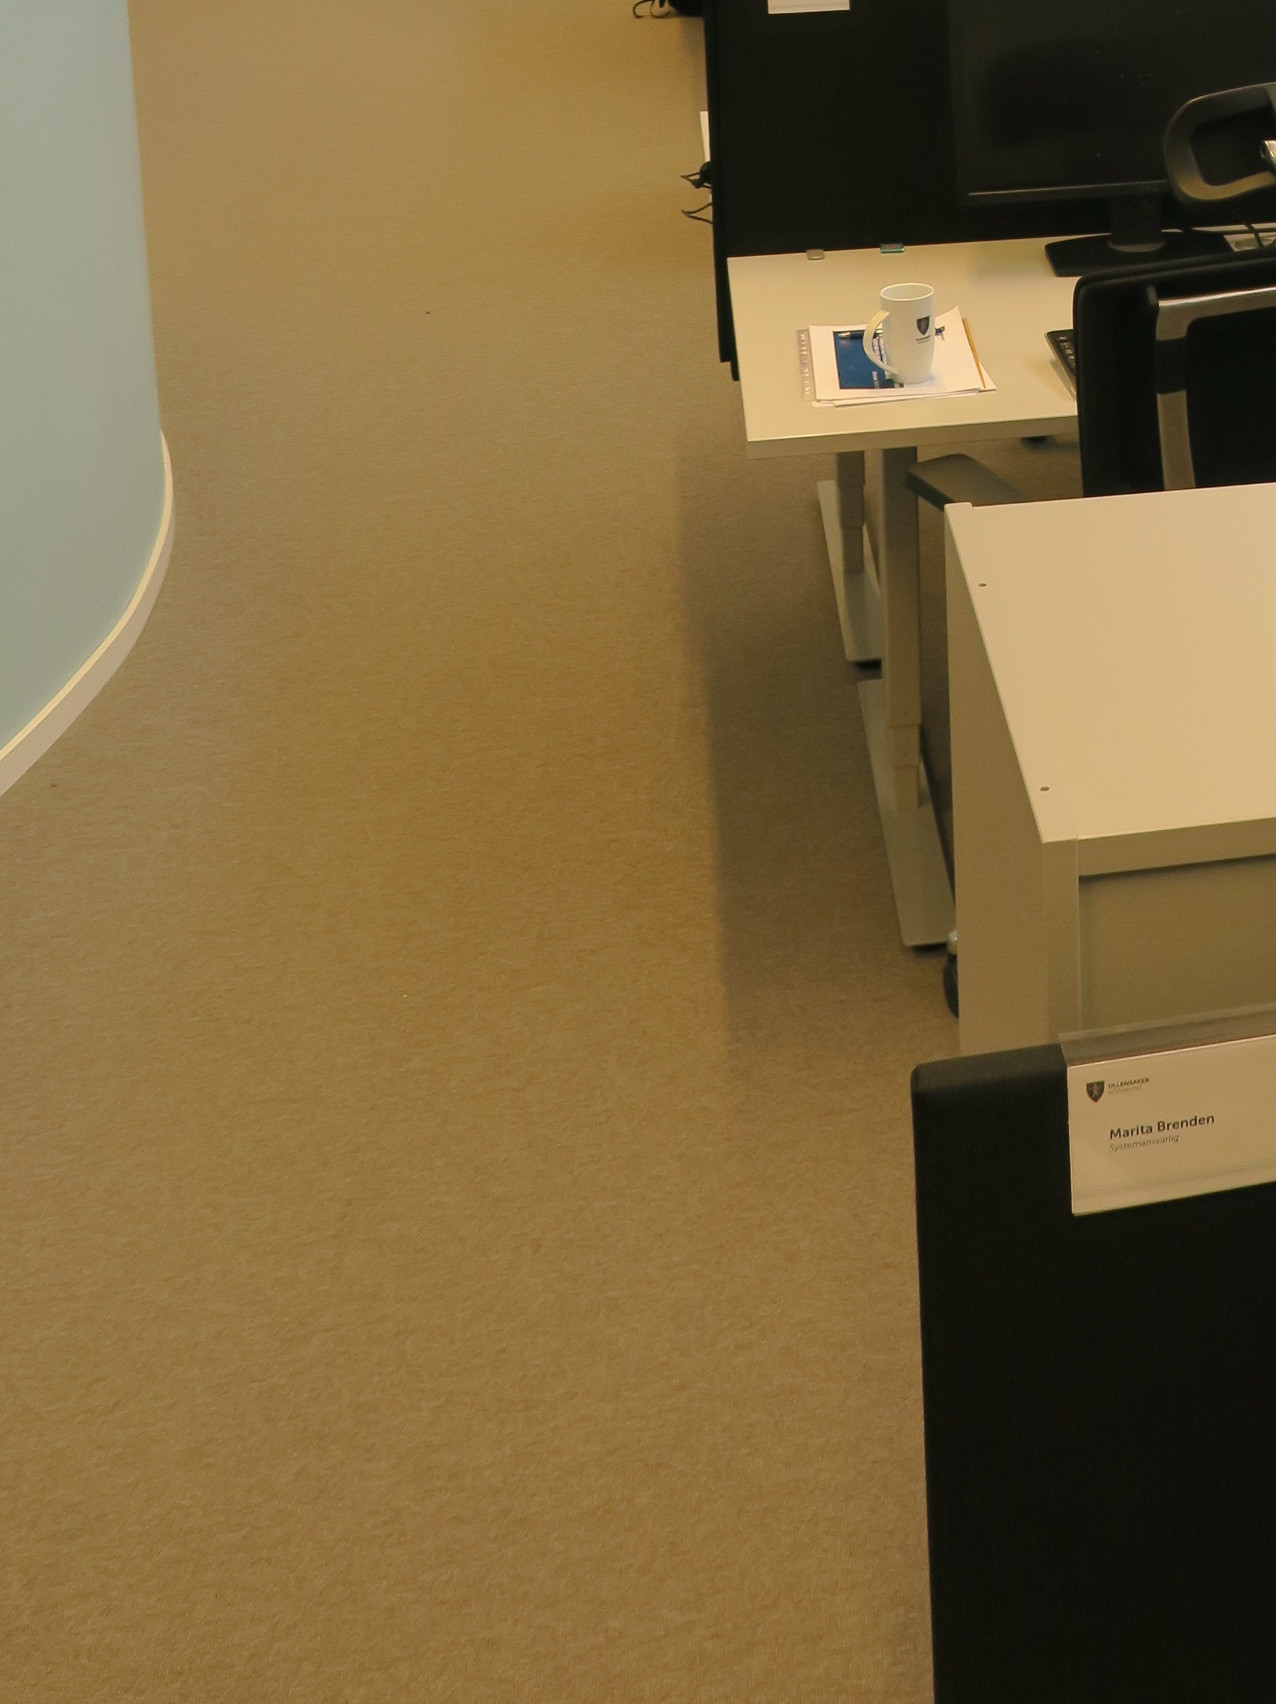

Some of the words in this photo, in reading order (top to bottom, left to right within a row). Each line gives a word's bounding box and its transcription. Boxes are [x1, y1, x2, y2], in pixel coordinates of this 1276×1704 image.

[1109, 1124, 1153, 1140] Marita
[1157, 1114, 1215, 1133] Brenden
[1109, 1134, 1180, 1153] Systemansvarlig
